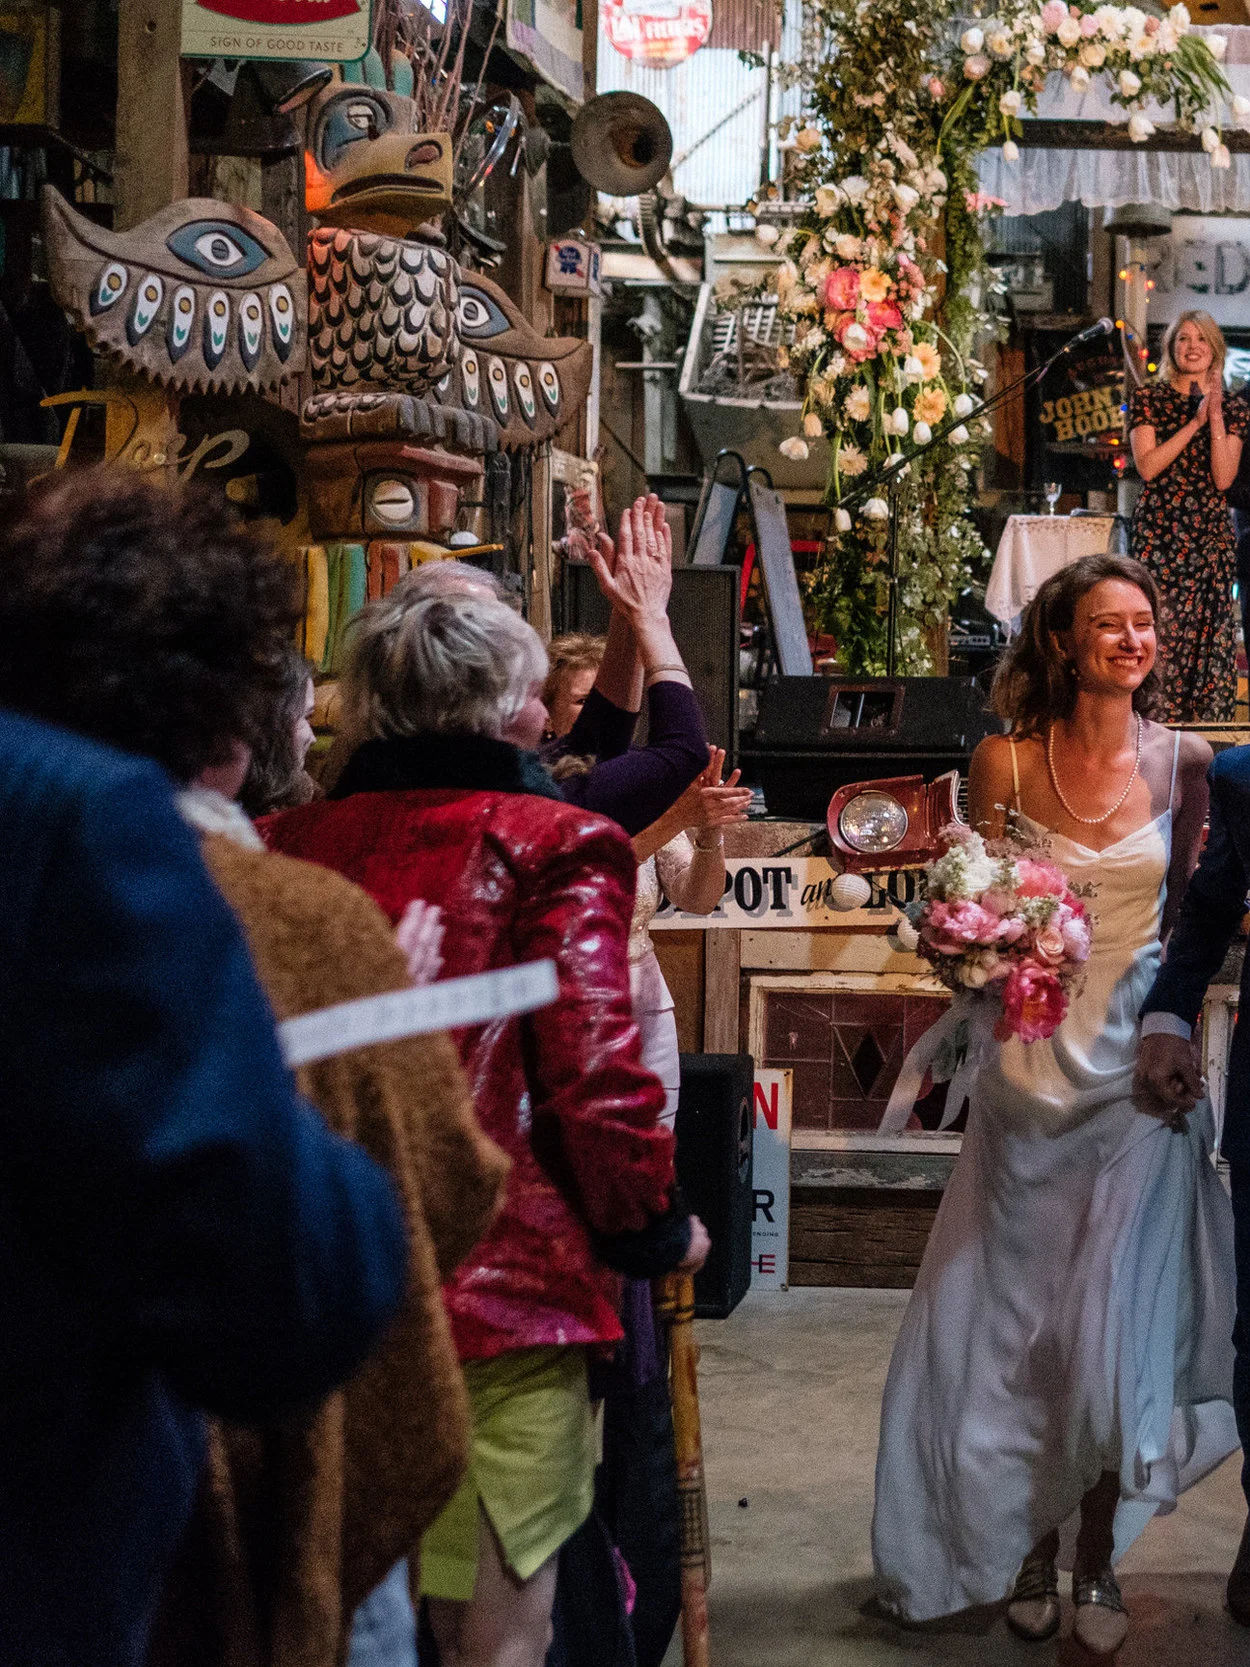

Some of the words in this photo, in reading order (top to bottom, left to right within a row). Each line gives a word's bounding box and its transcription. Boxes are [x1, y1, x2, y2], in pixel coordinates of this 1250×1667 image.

[210, 36, 241, 49] SIGN
[246, 39, 262, 50] OF
[267, 38, 305, 51] GOOD
[308, 41, 344, 53] TASTE
